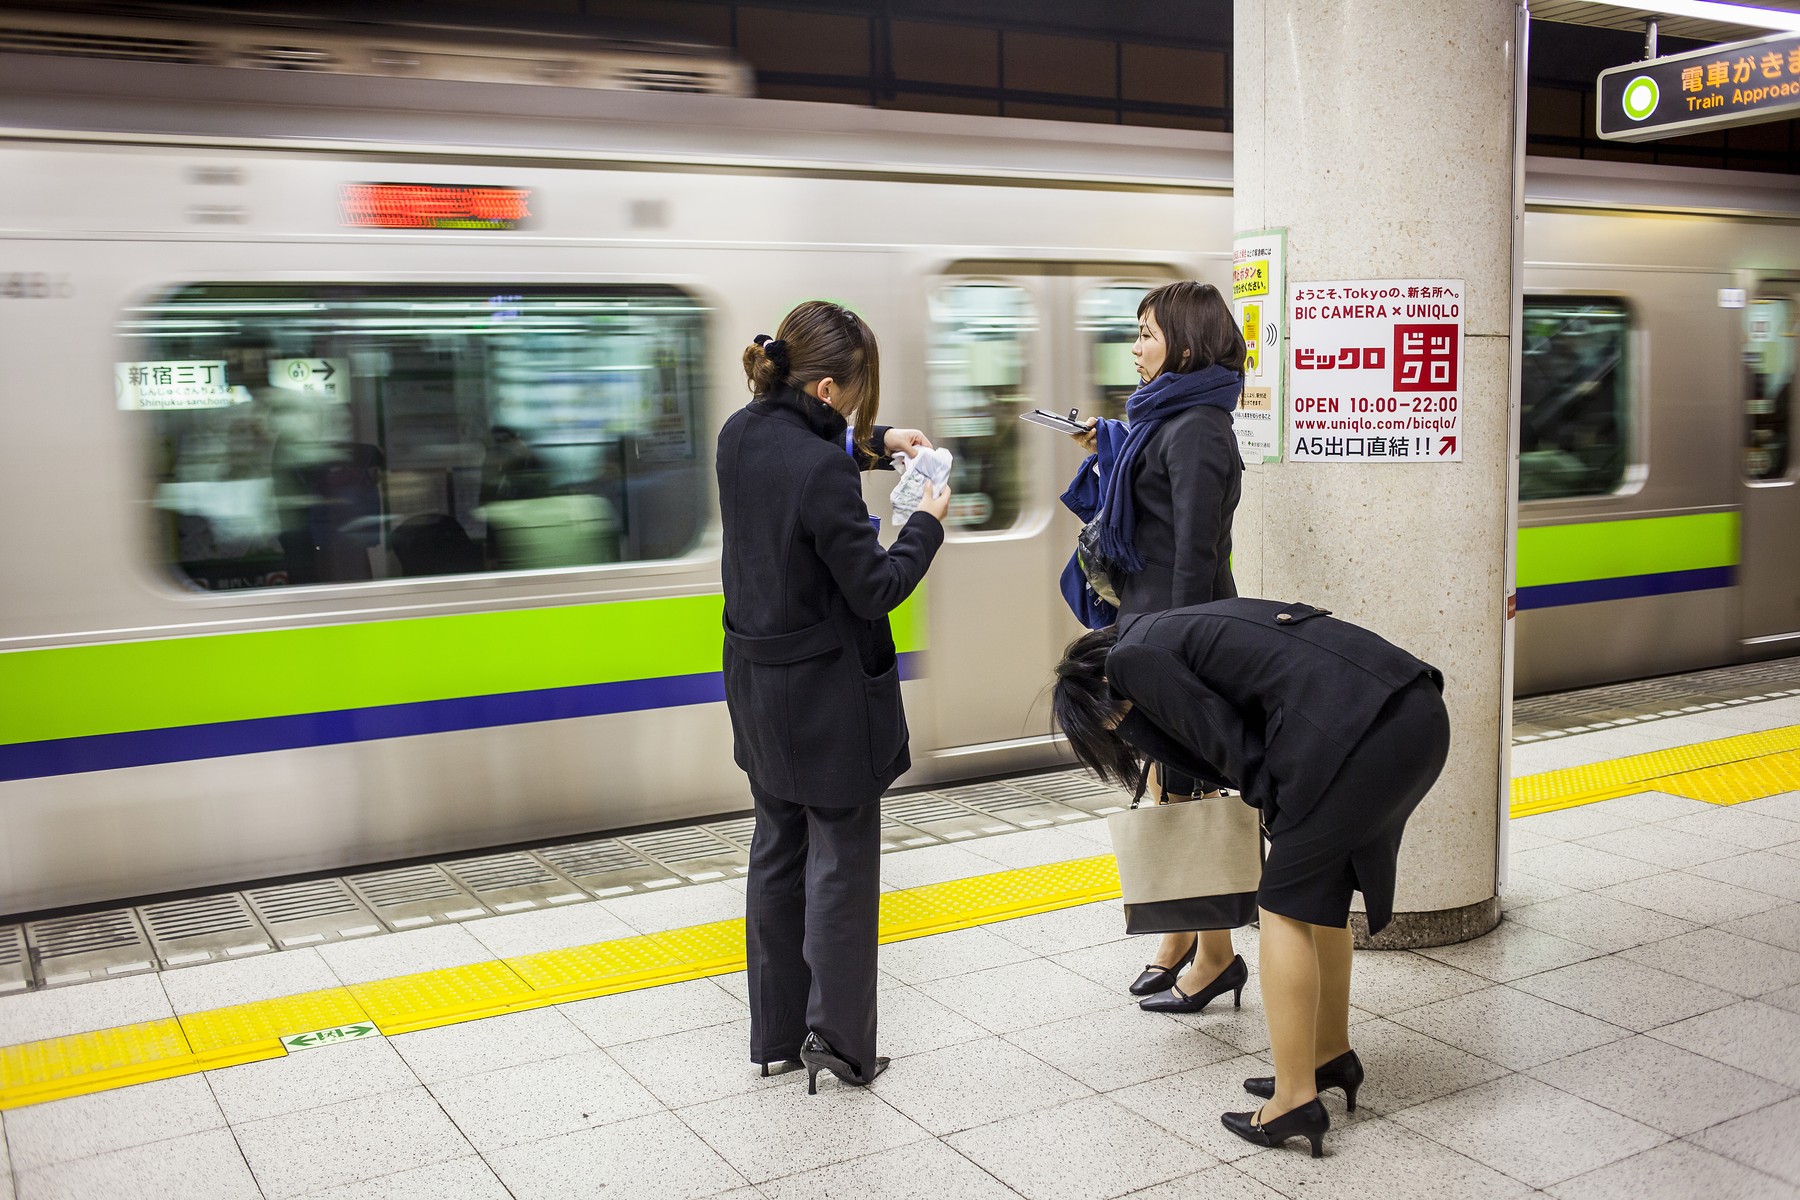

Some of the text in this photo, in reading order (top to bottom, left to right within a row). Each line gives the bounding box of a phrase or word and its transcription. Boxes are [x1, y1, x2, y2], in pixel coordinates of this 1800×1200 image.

[1686, 79, 1800, 112] Train Approac
[1295, 286, 1459, 300] ようこそ、Tokyoの、新名所へ。
[1295, 306, 1317, 320] BIC
[1321, 304, 1388, 319] CAMERA
[1406, 304, 1459, 321] UNIQLO
[1295, 347, 1386, 370] ビックロ
[128, 366, 228, 386] 新宿三丁
[1295, 397, 1339, 413] OPEN
[1295, 416, 1457, 433] www.uniqlo.com/bicqlo/
